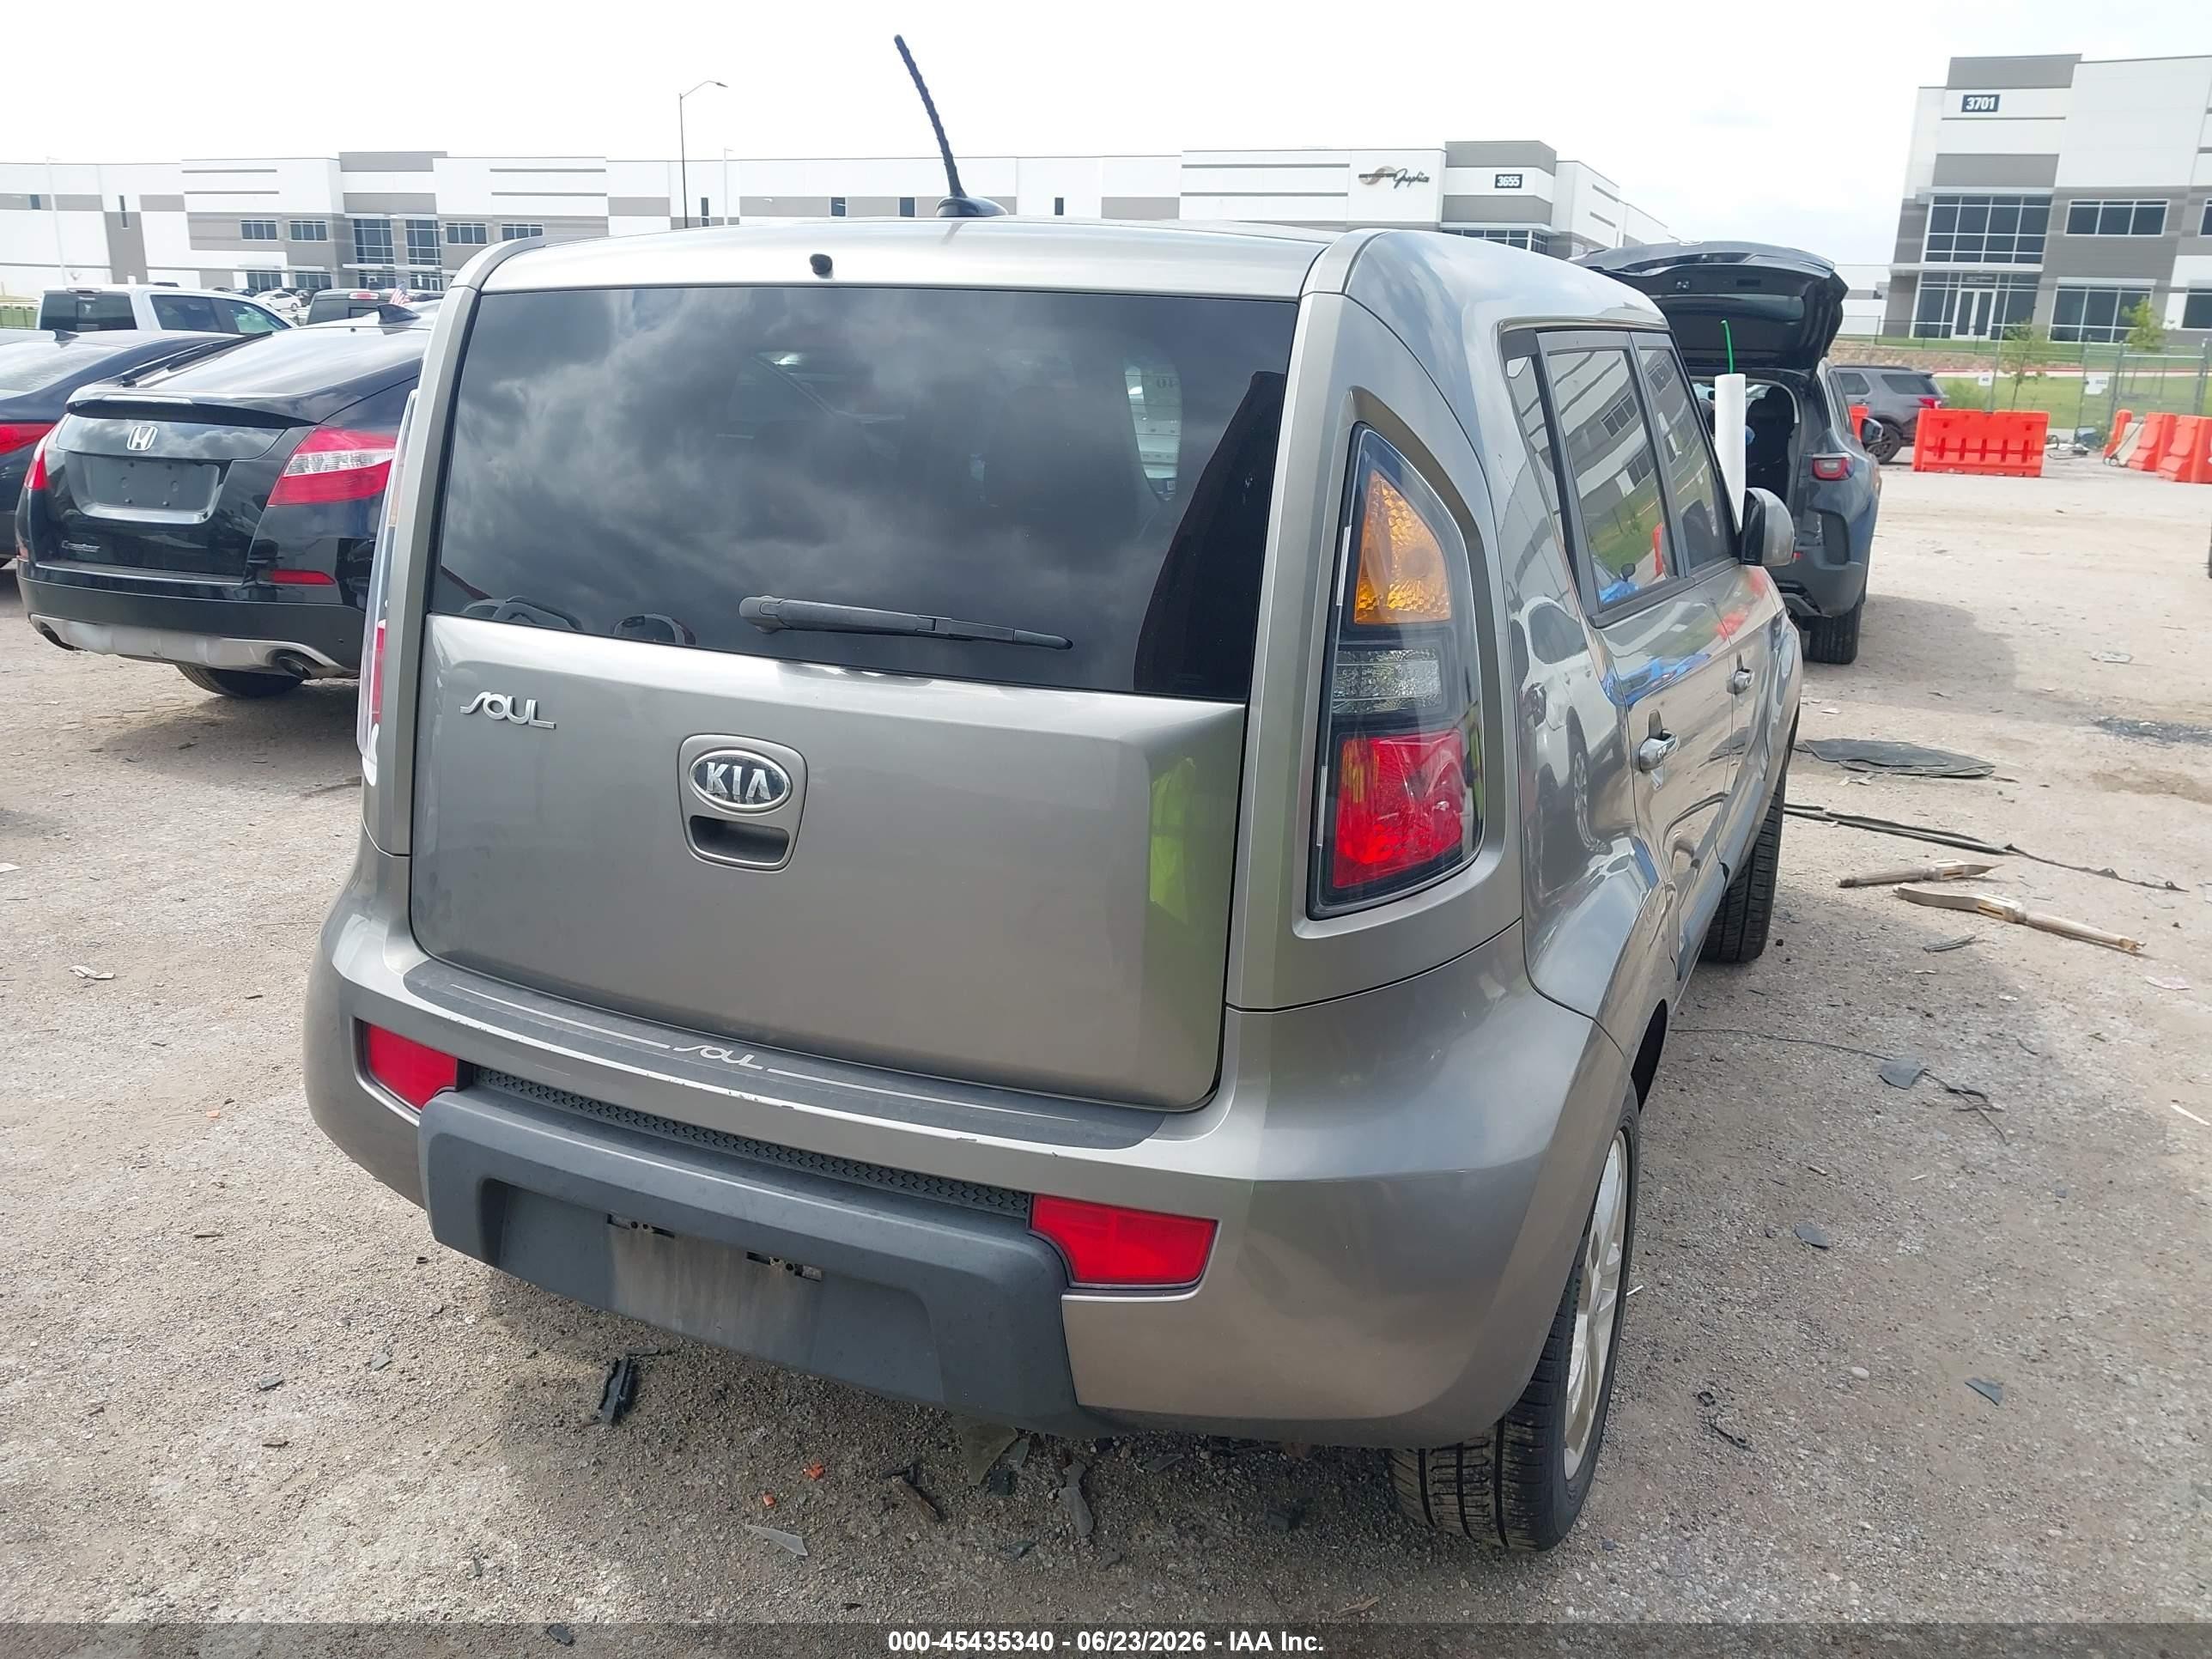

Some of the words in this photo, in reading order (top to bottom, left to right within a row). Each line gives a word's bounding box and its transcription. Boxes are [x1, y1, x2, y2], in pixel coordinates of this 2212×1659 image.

[1966, 96, 1996, 110] 3701
[1497, 175, 1521, 187] 3655
[706, 761, 773, 801] KIA
